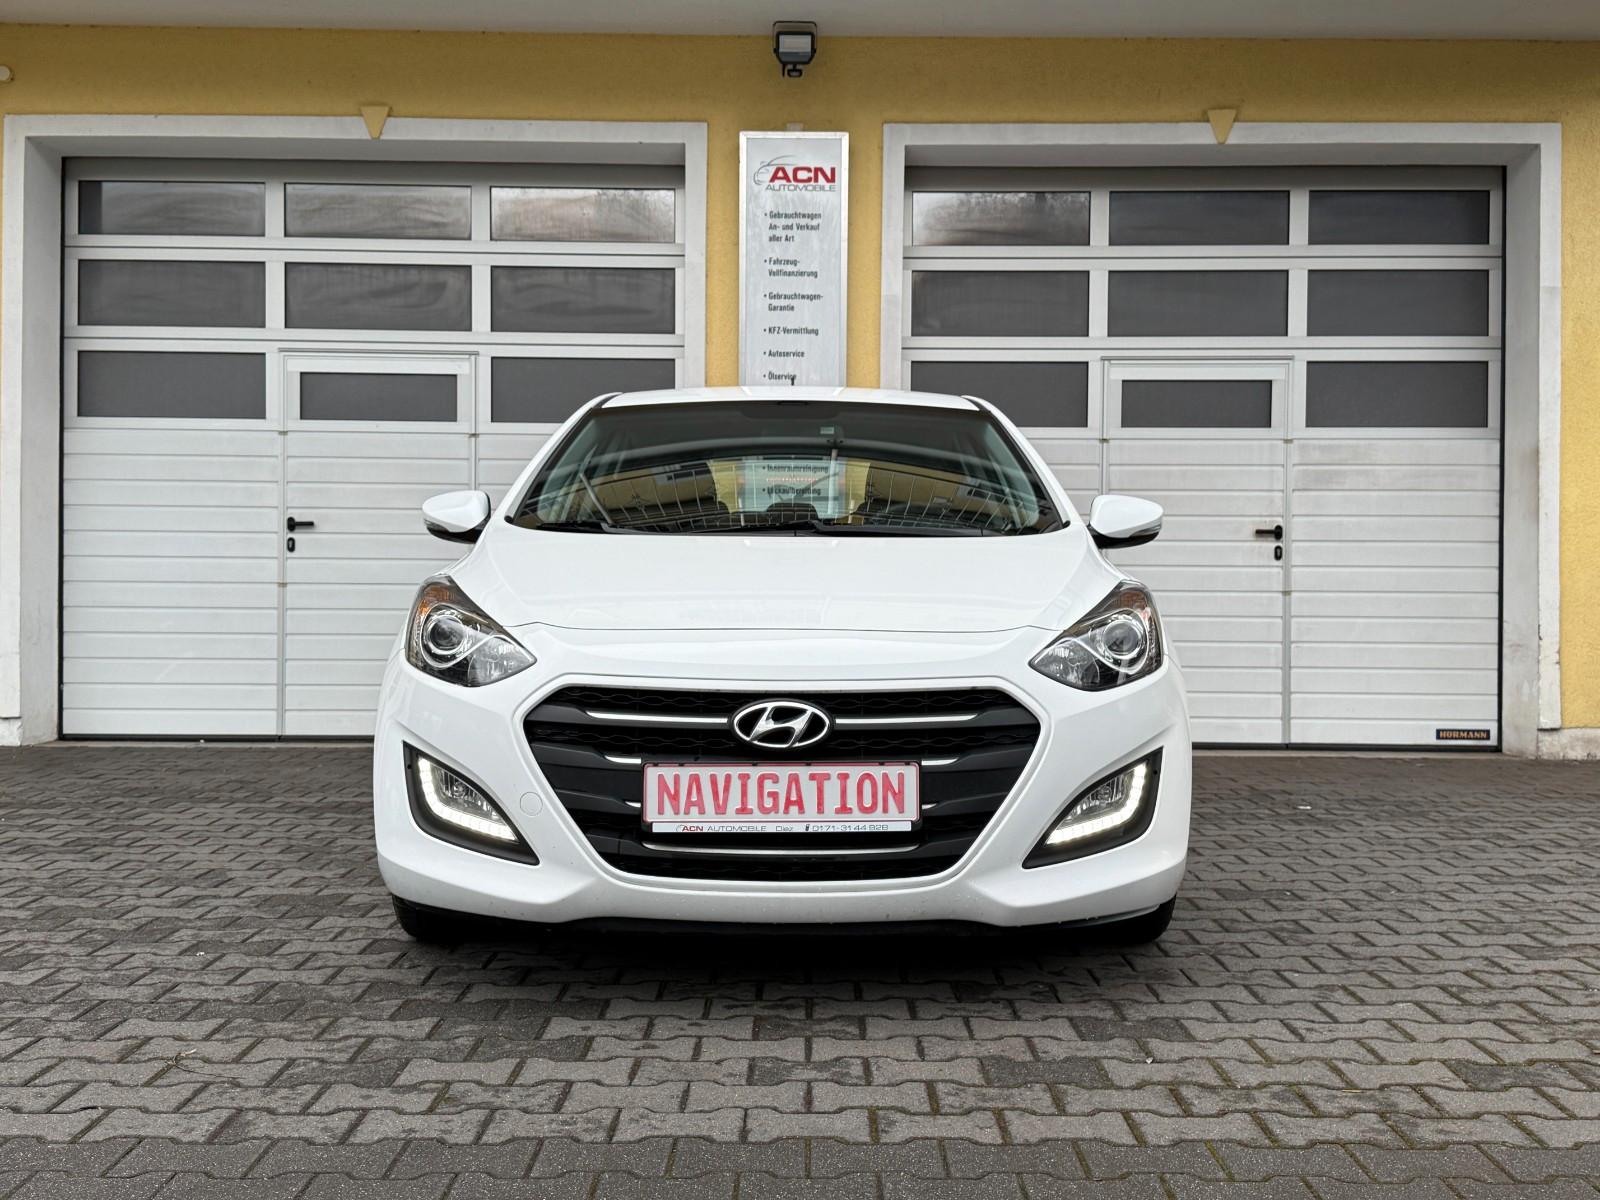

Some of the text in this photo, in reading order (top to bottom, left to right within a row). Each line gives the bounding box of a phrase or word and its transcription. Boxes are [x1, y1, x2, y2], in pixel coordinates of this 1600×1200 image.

[769, 166, 836, 183] ACN
[765, 184, 837, 192] AUTOMOBILE
[769, 211, 822, 221] Gebrauchtwagen
[768, 223, 820, 231] An- und Verkauf
[768, 235, 782, 243] aller
[769, 257, 800, 266] Fahrzeug-
[768, 292, 823, 301] Gebrauchtwagen-
[768, 304, 795, 312] Garantie
[768, 327, 819, 336] KFZ-Vermittlung
[768, 350, 805, 358] Autoservice
[657, 773, 905, 815] NAVIGATION
